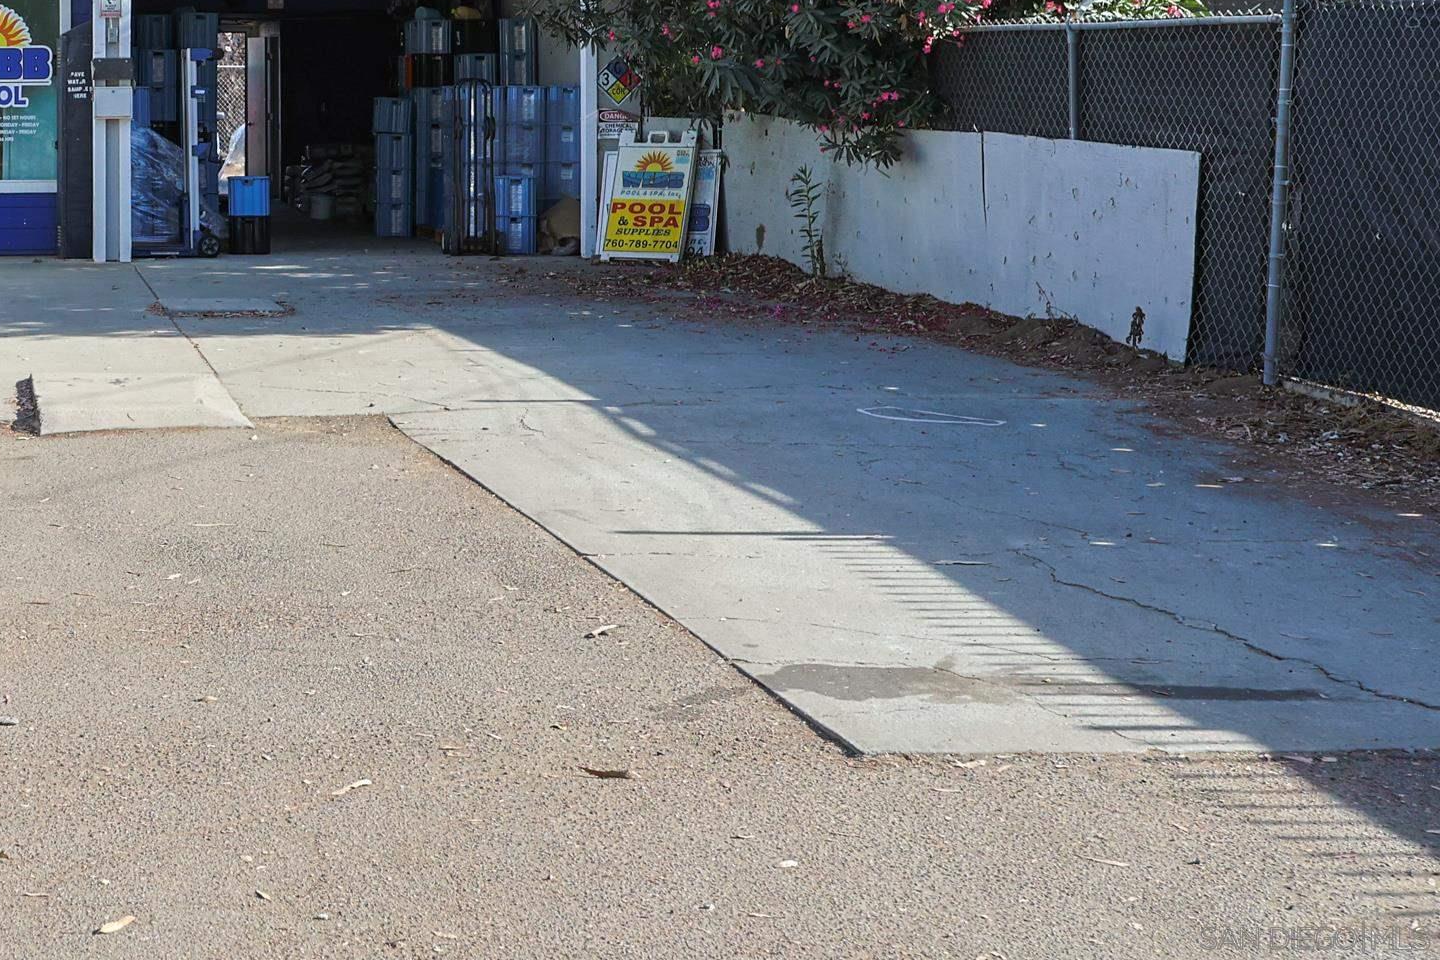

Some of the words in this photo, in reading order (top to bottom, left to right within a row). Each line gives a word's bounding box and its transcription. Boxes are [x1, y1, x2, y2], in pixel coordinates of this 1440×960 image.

[601, 72, 610, 86] 3
[611, 202, 682, 215] POOL
[618, 216, 628, 226] &
[633, 216, 679, 228] SPA
[615, 228, 671, 236] SUPPLIES
[605, 239, 678, 248] 760-789-7704
